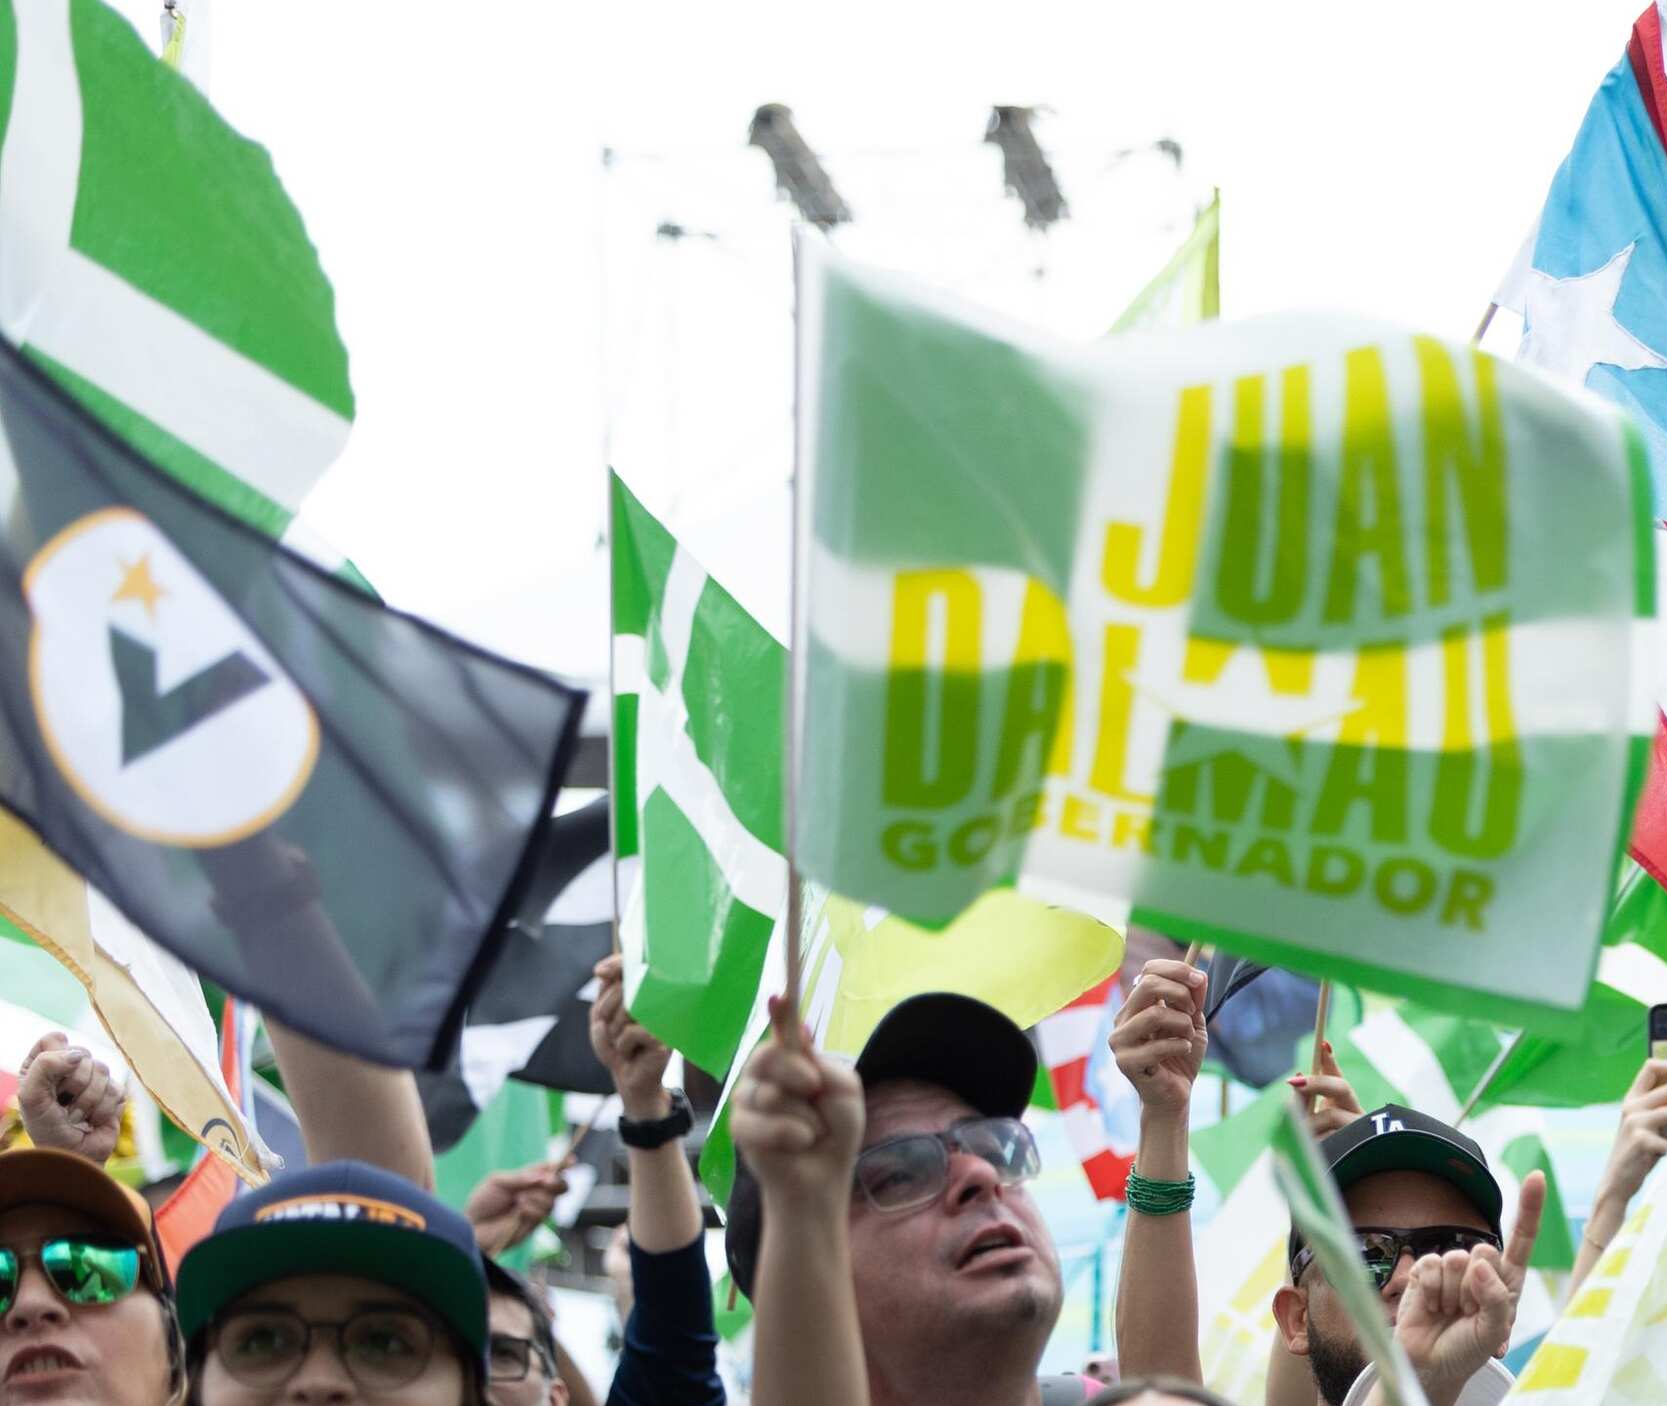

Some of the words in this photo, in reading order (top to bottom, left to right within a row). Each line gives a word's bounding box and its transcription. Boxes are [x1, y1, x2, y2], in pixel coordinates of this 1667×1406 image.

[1101, 334, 1509, 627] JUAN
[880, 566, 1524, 862] DALMAU
[880, 796, 1496, 934] GOBERNADOR
